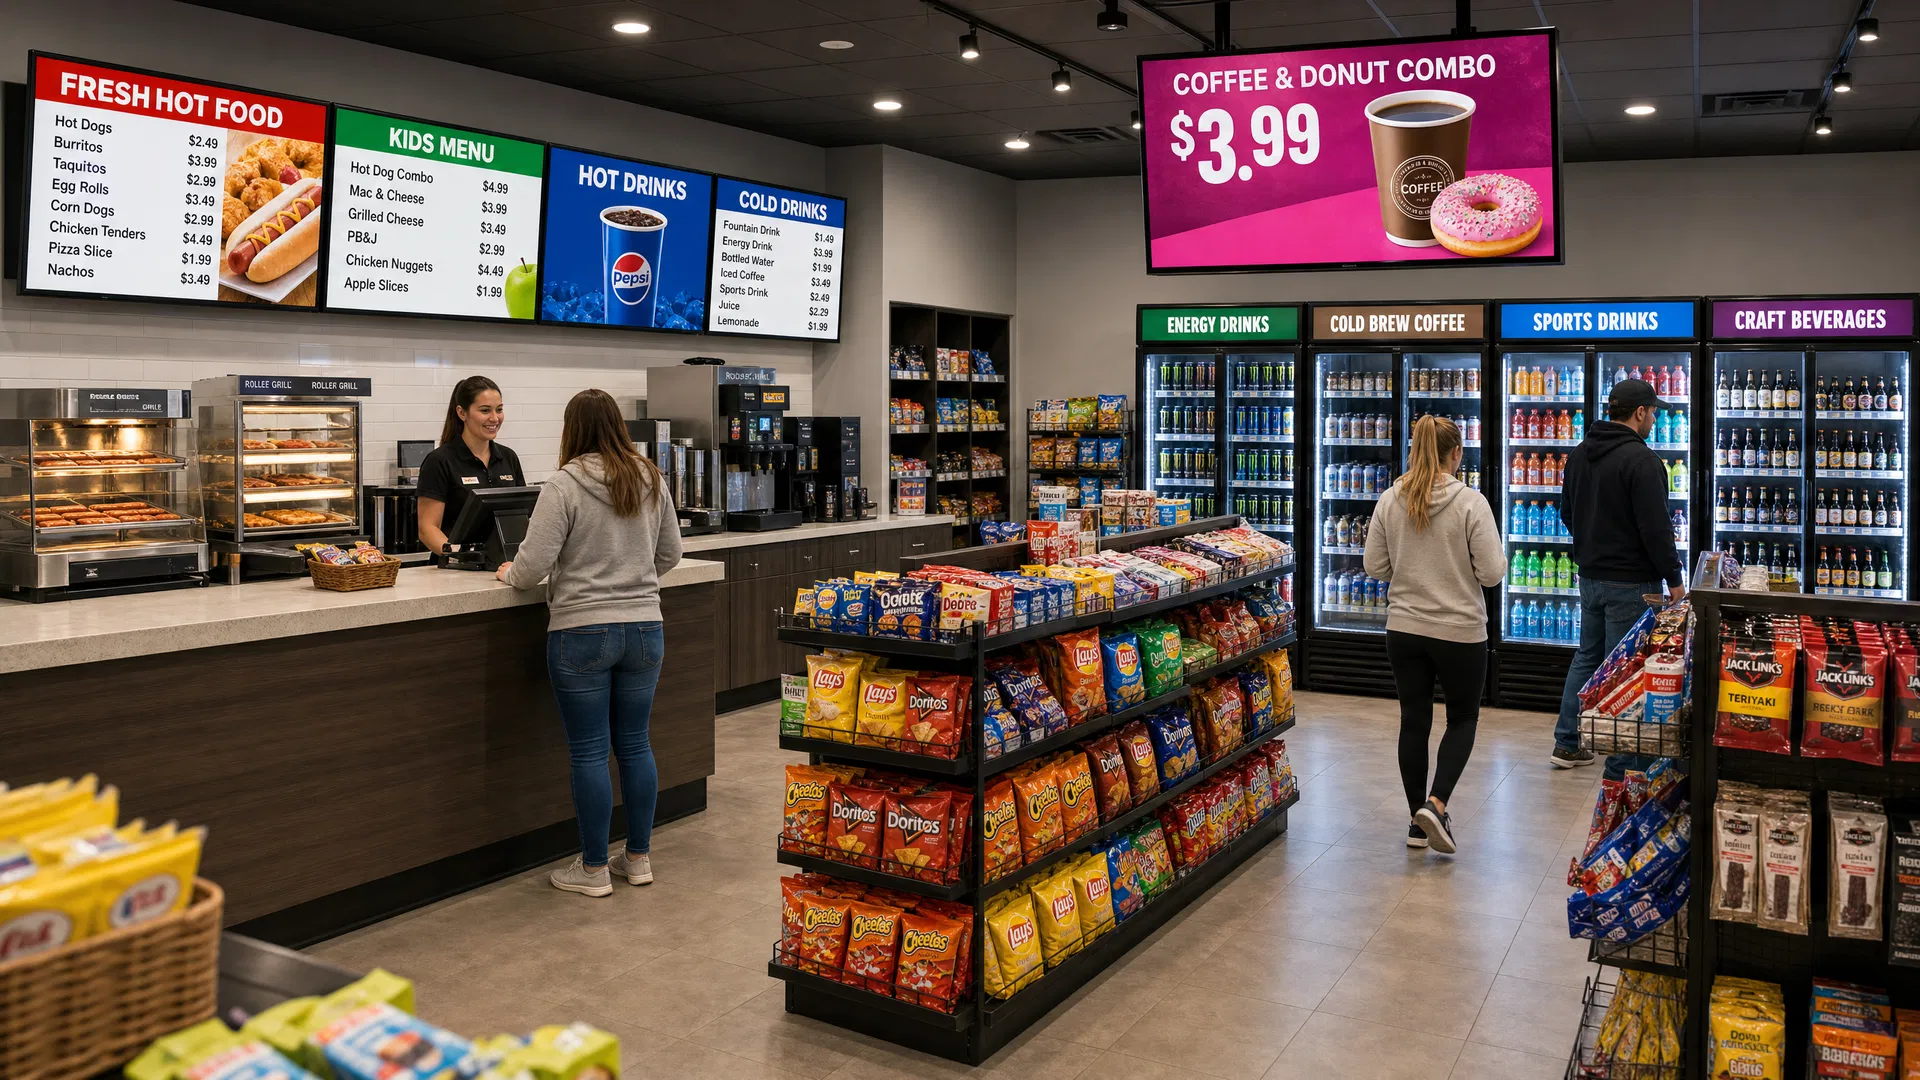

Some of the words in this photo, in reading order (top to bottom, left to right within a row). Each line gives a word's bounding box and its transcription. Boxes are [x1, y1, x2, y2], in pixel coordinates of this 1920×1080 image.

[1174, 68, 1268, 95] COFFEE
[1275, 67, 1294, 89] &
[1301, 61, 1389, 87] DONUT
[1397, 54, 1495, 82] COMBO
[61, 72, 150, 108] FRESH
[156, 88, 209, 117] HOT
[215, 98, 283, 128] FOOD
[56, 115, 77, 129] Hot
[81, 118, 112, 135] Dogs
[54, 136, 102, 153] Burritos
[189, 134, 218, 149] $2.49
[390, 127, 434, 153] KIDS
[440, 136, 494, 163] MENU
[1170, 102, 1320, 185] $3.99
[53, 157, 106, 174] Taquitos
[188, 154, 217, 168] $3.99
[351, 161, 370, 175] Hot
[373, 165, 394, 181] Dog
[397, 168, 433, 183] Combo
[52, 178, 75, 194] Egg
[80, 181, 108, 195] Rolls
[187, 173, 216, 187] $2.99
[483, 180, 508, 194] $4.99
[579, 165, 619, 190] HOT
[624, 172, 686, 200] DRINKS
[1401, 181, 1443, 194] COFFEE
[186, 193, 214, 206] $3.49
[350, 184, 372, 198] Mac
[376, 188, 383, 200] &
[387, 189, 424, 204] Cheese
[51, 199, 80, 213] Corn
[84, 202, 114, 218] Dogs
[482, 201, 507, 214] $3.99
[739, 191, 777, 212] COLD
[781, 198, 827, 221] DRINKS
[184, 213, 213, 226] $2.99
[349, 208, 383, 222] Grilled
[387, 212, 424, 227] Cheese
[50, 220, 98, 235] Chicken
[101, 225, 146, 240] Tenders
[481, 221, 506, 235] $3.49
[724, 220, 758, 233] Fountain
[760, 225, 780, 236] Drink
[183, 232, 212, 245] $4.49
[348, 230, 377, 244] PB&J
[723, 236, 750, 250] Energy
[752, 240, 772, 251] Drink
[815, 232, 834, 243] $1.49
[49, 242, 80, 255] Pizza
[84, 245, 112, 258] Slice
[479, 243, 504, 256] $2.99
[814, 247, 833, 258] $3.99
[182, 252, 211, 265] $1.99
[346, 254, 388, 268] Chicken
[391, 258, 433, 274] Nuggets
[722, 252, 749, 264] Bottled
[752, 256, 774, 267] Water
[48, 263, 94, 278] Nachos
[478, 264, 503, 276] $4.49
[721, 268, 738, 278] Iced
[740, 270, 765, 281] Coffee
[812, 262, 832, 273] $1.99
[181, 272, 210, 285] $3.49
[344, 277, 375, 292] Apple
[379, 279, 408, 292] Slices
[613, 270, 649, 286] pepsi
[811, 277, 831, 287] $3.49
[477, 285, 502, 297] $1.99
[720, 284, 745, 295] Sports
[748, 287, 768, 297] Drink
[810, 292, 830, 302] $2.49
[719, 300, 740, 310] Juice
[809, 307, 828, 316] $2.29
[718, 316, 759, 327] Lemonade
[808, 321, 828, 331] $1.99
[1168, 316, 1216, 333] ENERGY
[1220, 316, 1269, 332] DRINKS
[1331, 315, 1364, 332] COLD
[1370, 315, 1410, 332] BREW
[1415, 314, 1465, 332] COFFEE
[1534, 312, 1592, 331] SPORTS
[1598, 312, 1658, 330] DRINKS
[1735, 311, 1786, 329] CRAFT
[1792, 309, 1886, 329] BEVERAGES
[1725, 658, 1751, 672] JACK
[1815, 670, 1841, 683] JACK
[909, 696, 948, 711] Doritos
[1728, 693, 1776, 707] TERIYAKI
[832, 802, 877, 823] Doritos
[887, 810, 940, 833] Doritos
